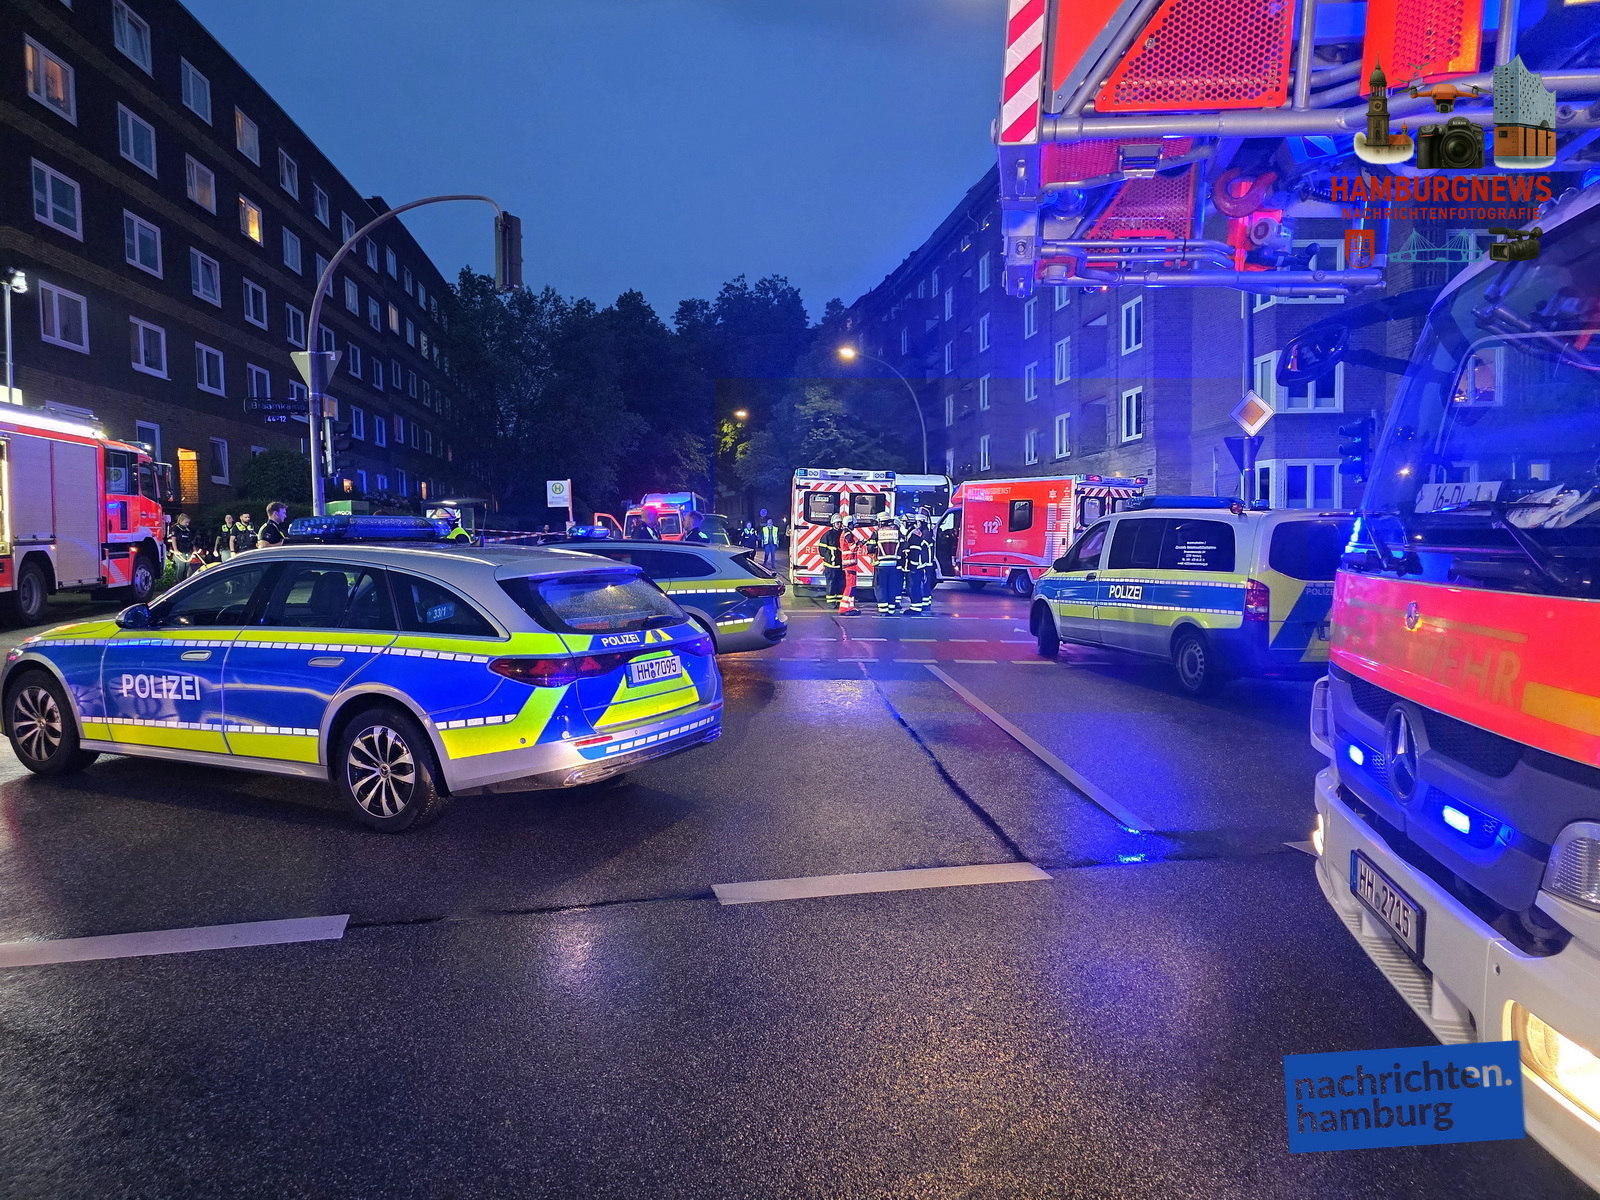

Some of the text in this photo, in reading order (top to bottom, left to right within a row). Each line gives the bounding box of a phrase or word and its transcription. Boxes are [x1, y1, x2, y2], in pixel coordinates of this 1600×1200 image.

[983, 521, 999, 534] 112
[1108, 584, 1143, 600] POLIZEI
[1306, 587, 1334, 596] POLIZE
[601, 633, 640, 647] POLIZEI
[636, 658, 677, 680] HH 7095
[122, 673, 201, 701] POLIZEI
[1360, 863, 1411, 939] HH 2715
